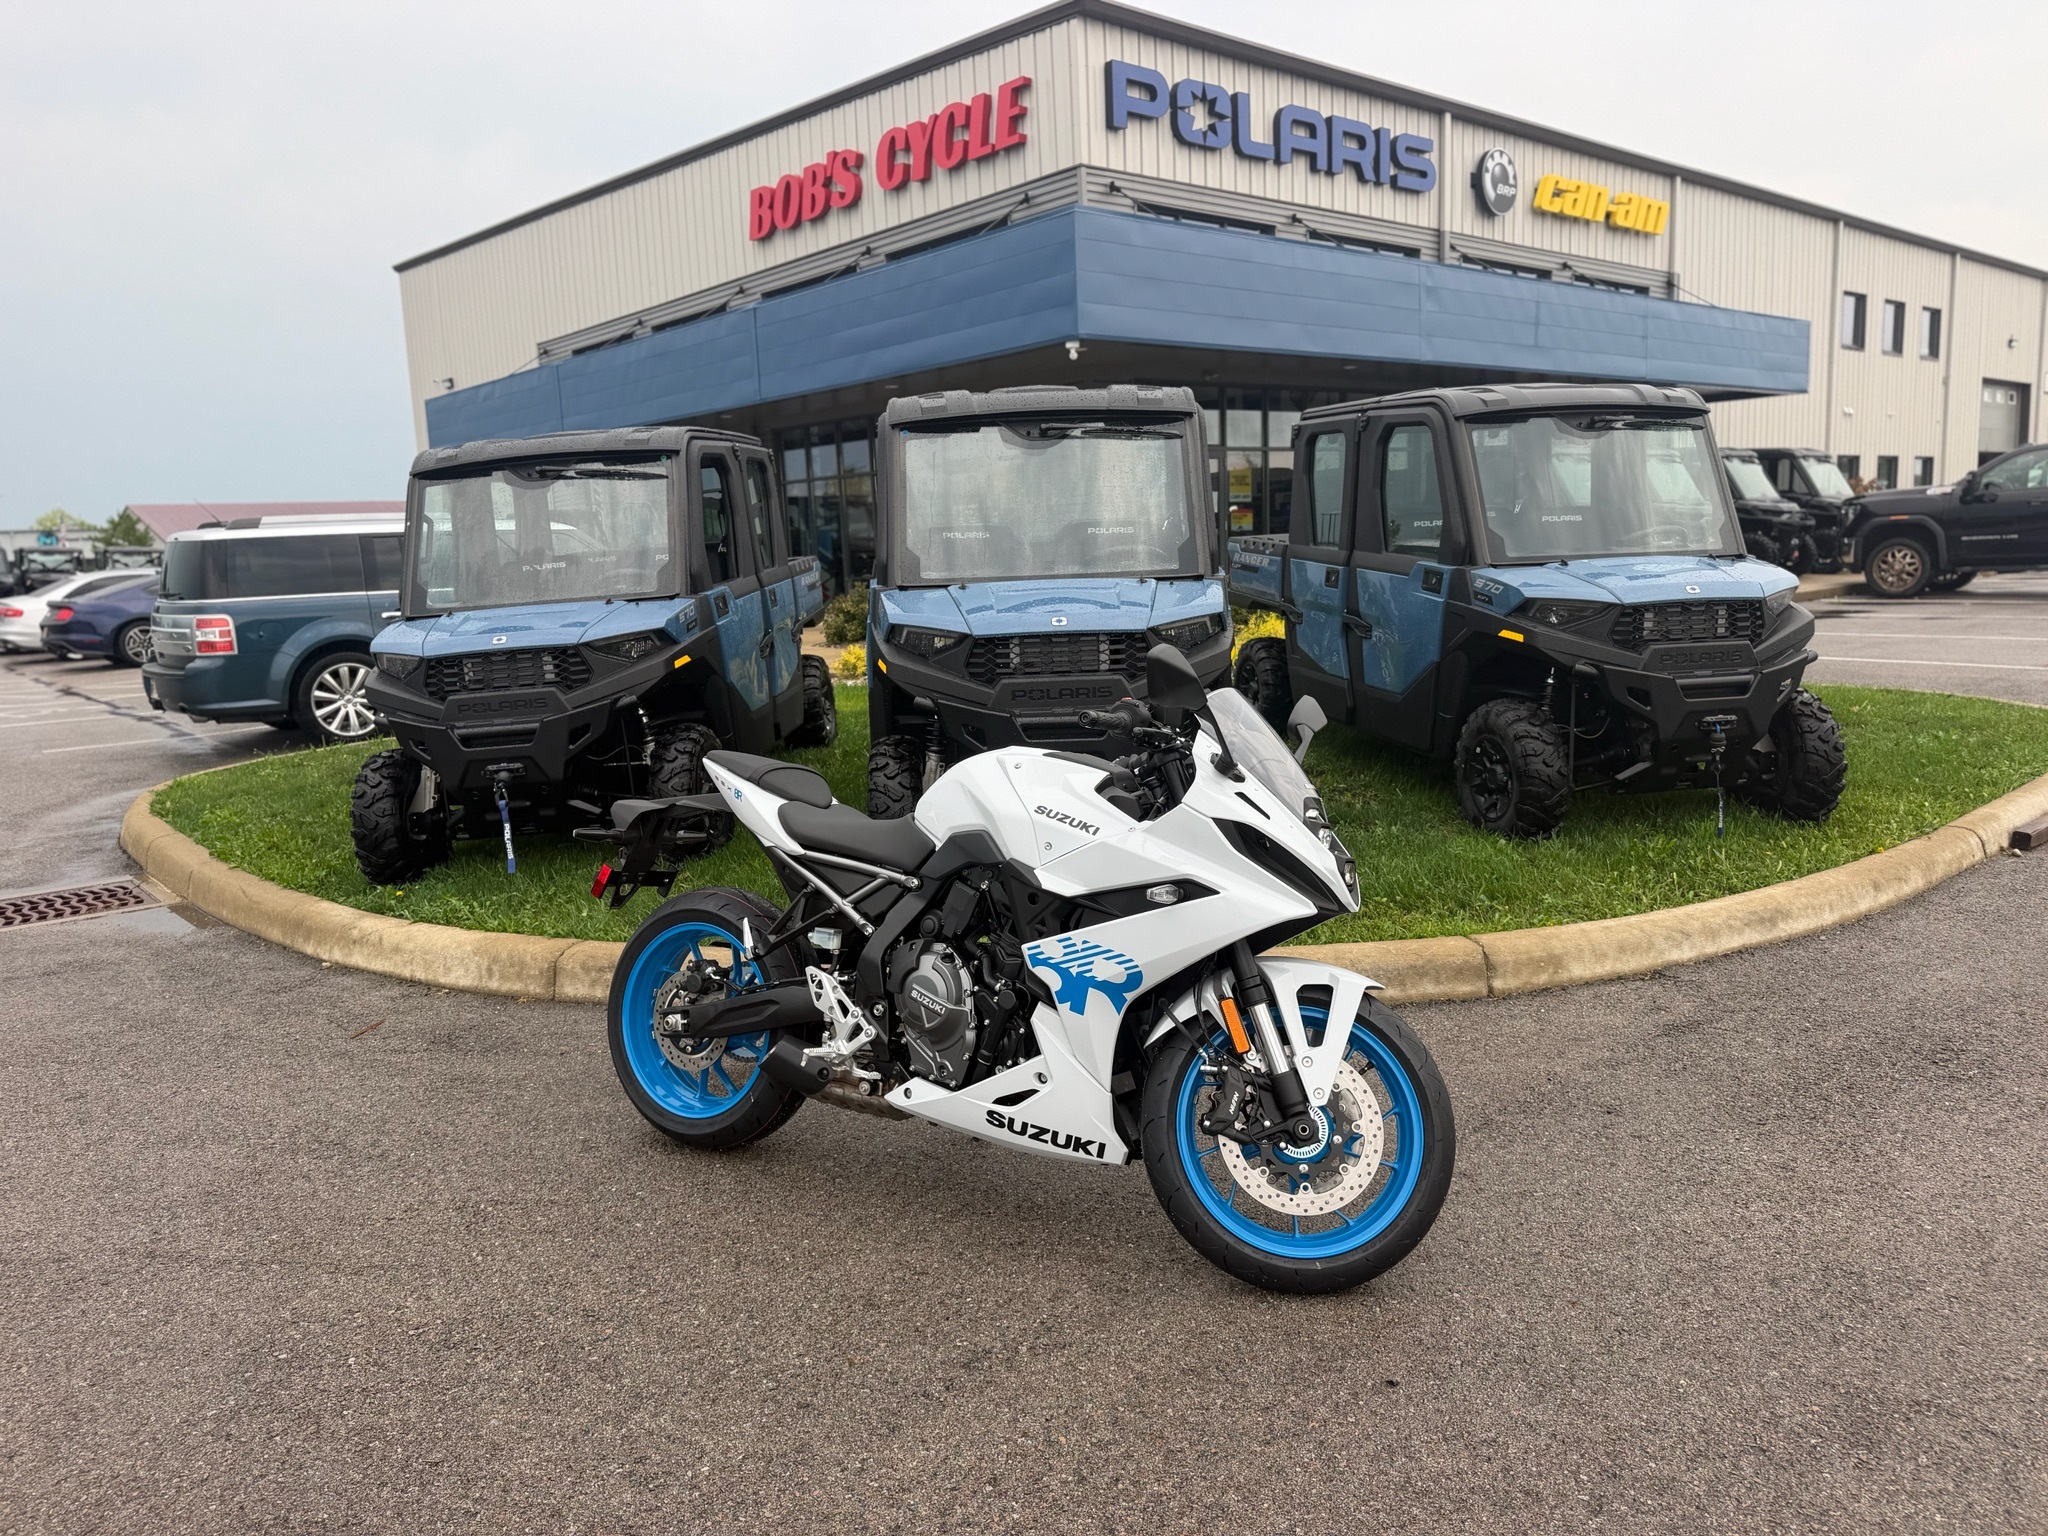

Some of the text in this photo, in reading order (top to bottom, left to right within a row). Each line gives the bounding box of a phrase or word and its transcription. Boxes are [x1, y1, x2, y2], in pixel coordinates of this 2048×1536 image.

[1105, 59, 1436, 193] POLARIS
[750, 76, 1031, 241] BOB'S CYCLE
[1496, 183, 1516, 197] BRP
[943, 531, 990, 539] POLARIS
[1088, 526, 1135, 534] POLARIS
[1233, 553, 1270, 567] RANGER
[1473, 578, 1504, 594] 570
[678, 604, 695, 623] 570
[1660, 650, 1743, 665] POLARIS
[1011, 686, 1114, 701] POLARIS
[457, 697, 548, 715] POLARIS
[1034, 805, 1101, 836] SUZUKI
[504, 823, 514, 860] POLARIS
[911, 989, 946, 1015] SUZUKI
[985, 1109, 1107, 1160] SUZUKI
